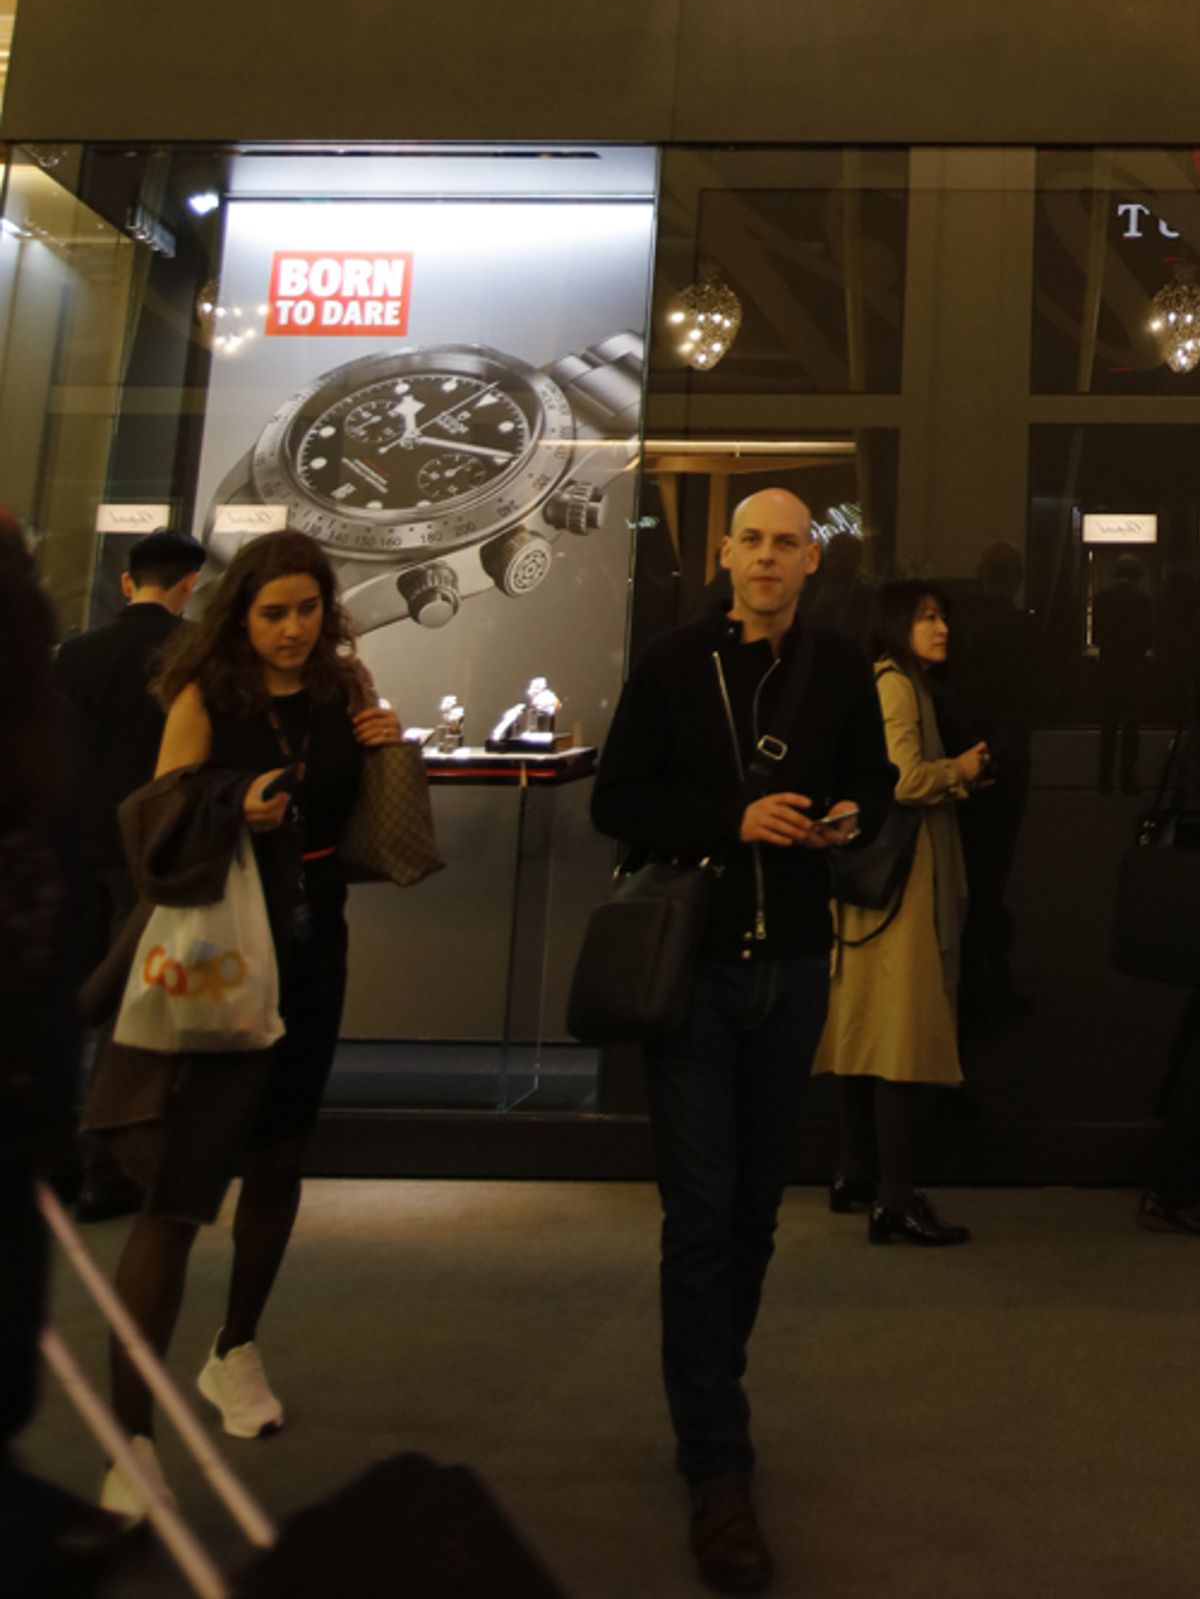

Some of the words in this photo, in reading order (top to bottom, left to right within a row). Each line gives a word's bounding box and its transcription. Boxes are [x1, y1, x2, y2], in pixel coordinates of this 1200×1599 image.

[278, 258, 405, 297] BORN
[276, 299, 315, 326] TO
[321, 299, 402, 326] DARE
[380, 534, 402, 547] 160
[420, 530, 442, 544] 180
